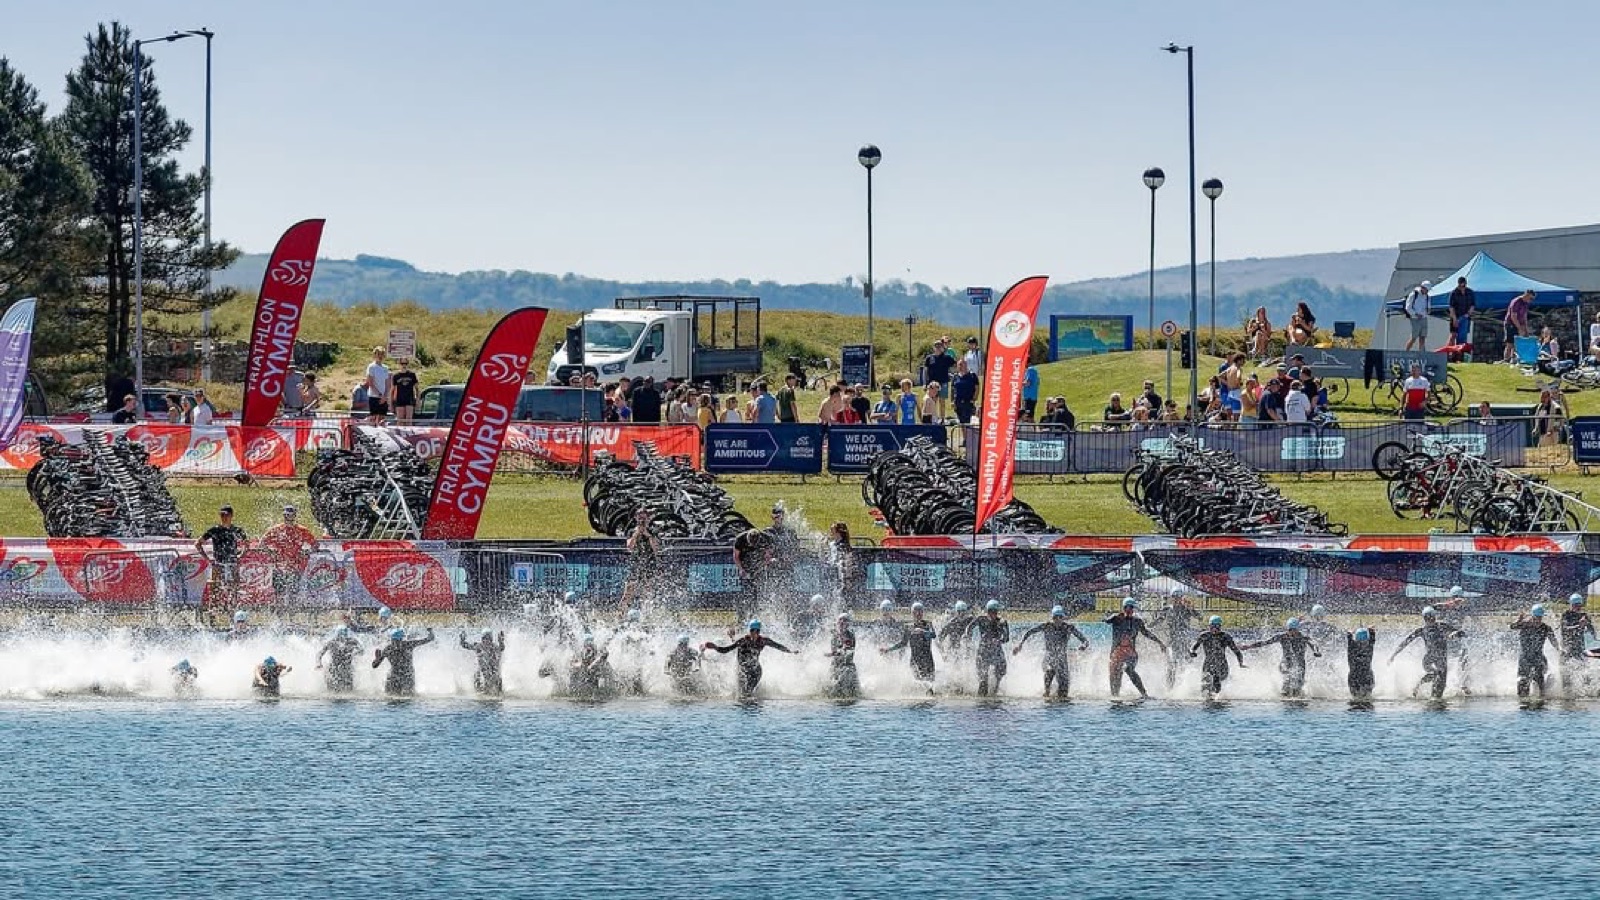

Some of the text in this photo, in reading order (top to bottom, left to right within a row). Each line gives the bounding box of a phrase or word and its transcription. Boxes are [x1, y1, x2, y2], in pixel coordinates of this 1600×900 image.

[247, 298, 277, 392] TRIATHLON
[260, 302, 299, 397] CYMRU
[982, 356, 1004, 504] Healthy Life Activities
[844, 434, 876, 444] WE DO
[1580, 431, 1596, 441] WE
[415, 437, 441, 459] OF
[713, 439, 748, 448] WE ARE
[844, 443, 884, 453] WHAT'S
[436, 396, 484, 504] TRIATHLON
[713, 449, 766, 458] AMBITIOUS
[1029, 449, 1059, 458] SERIES
[457, 402, 509, 514] CYMRU
[844, 453, 868, 463] RIGH
[544, 567, 580, 578] SUPER
[900, 568, 939, 577] SUPER
[1261, 569, 1300, 579] SUPER
[900, 578, 939, 587] SERIES
[1262, 580, 1300, 590] SERIES
